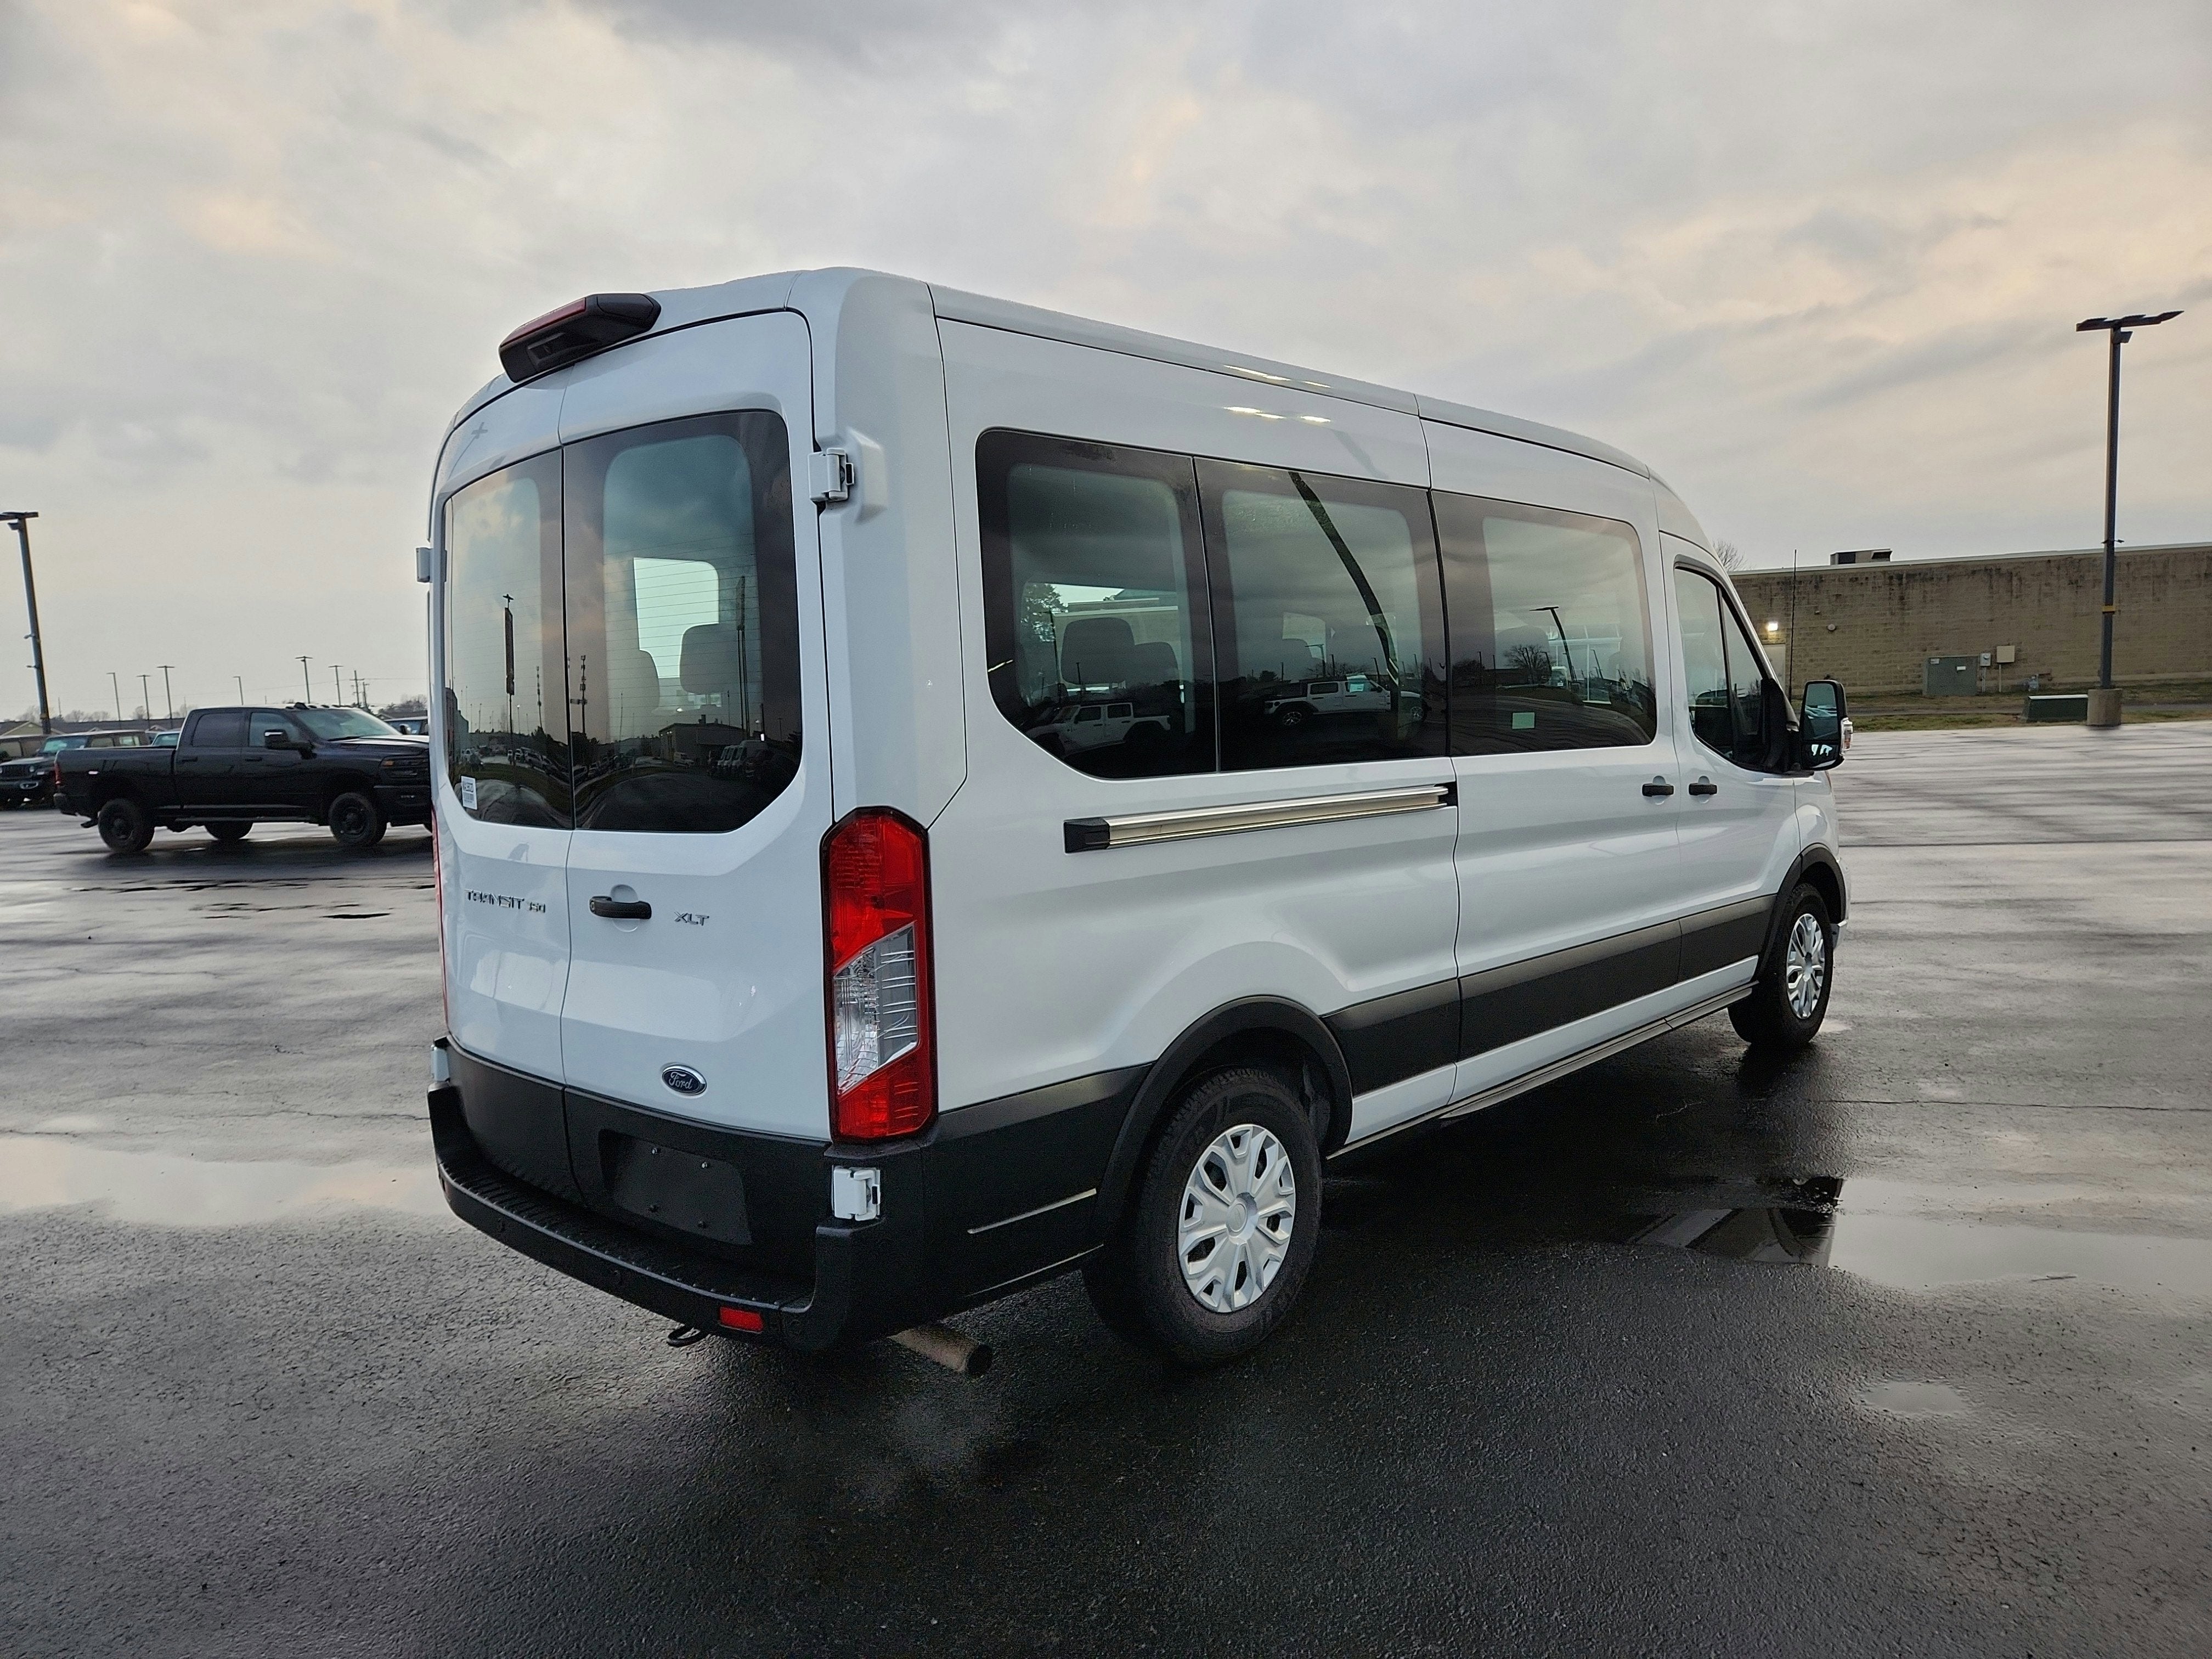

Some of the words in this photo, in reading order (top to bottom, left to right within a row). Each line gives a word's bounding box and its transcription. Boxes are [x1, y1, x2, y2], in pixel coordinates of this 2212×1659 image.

[464, 889, 524, 910] TRANSIT
[674, 911, 710, 926] XLT
[668, 1071, 692, 1089] Ford
